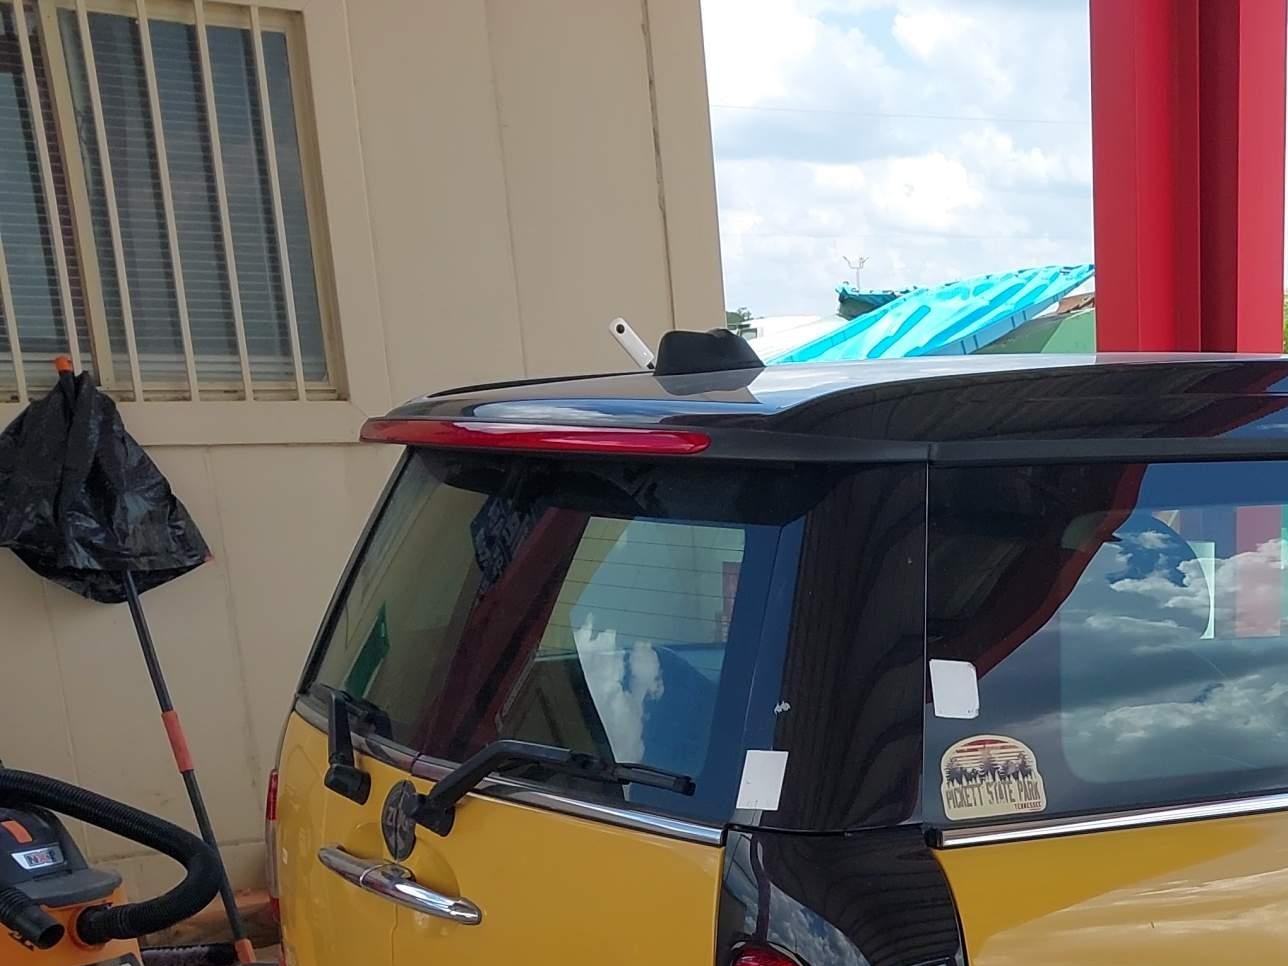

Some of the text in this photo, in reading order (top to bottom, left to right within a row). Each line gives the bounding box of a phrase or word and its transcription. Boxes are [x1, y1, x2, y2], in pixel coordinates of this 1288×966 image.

[946, 780, 1040, 808] PICKETT STATE PARK
